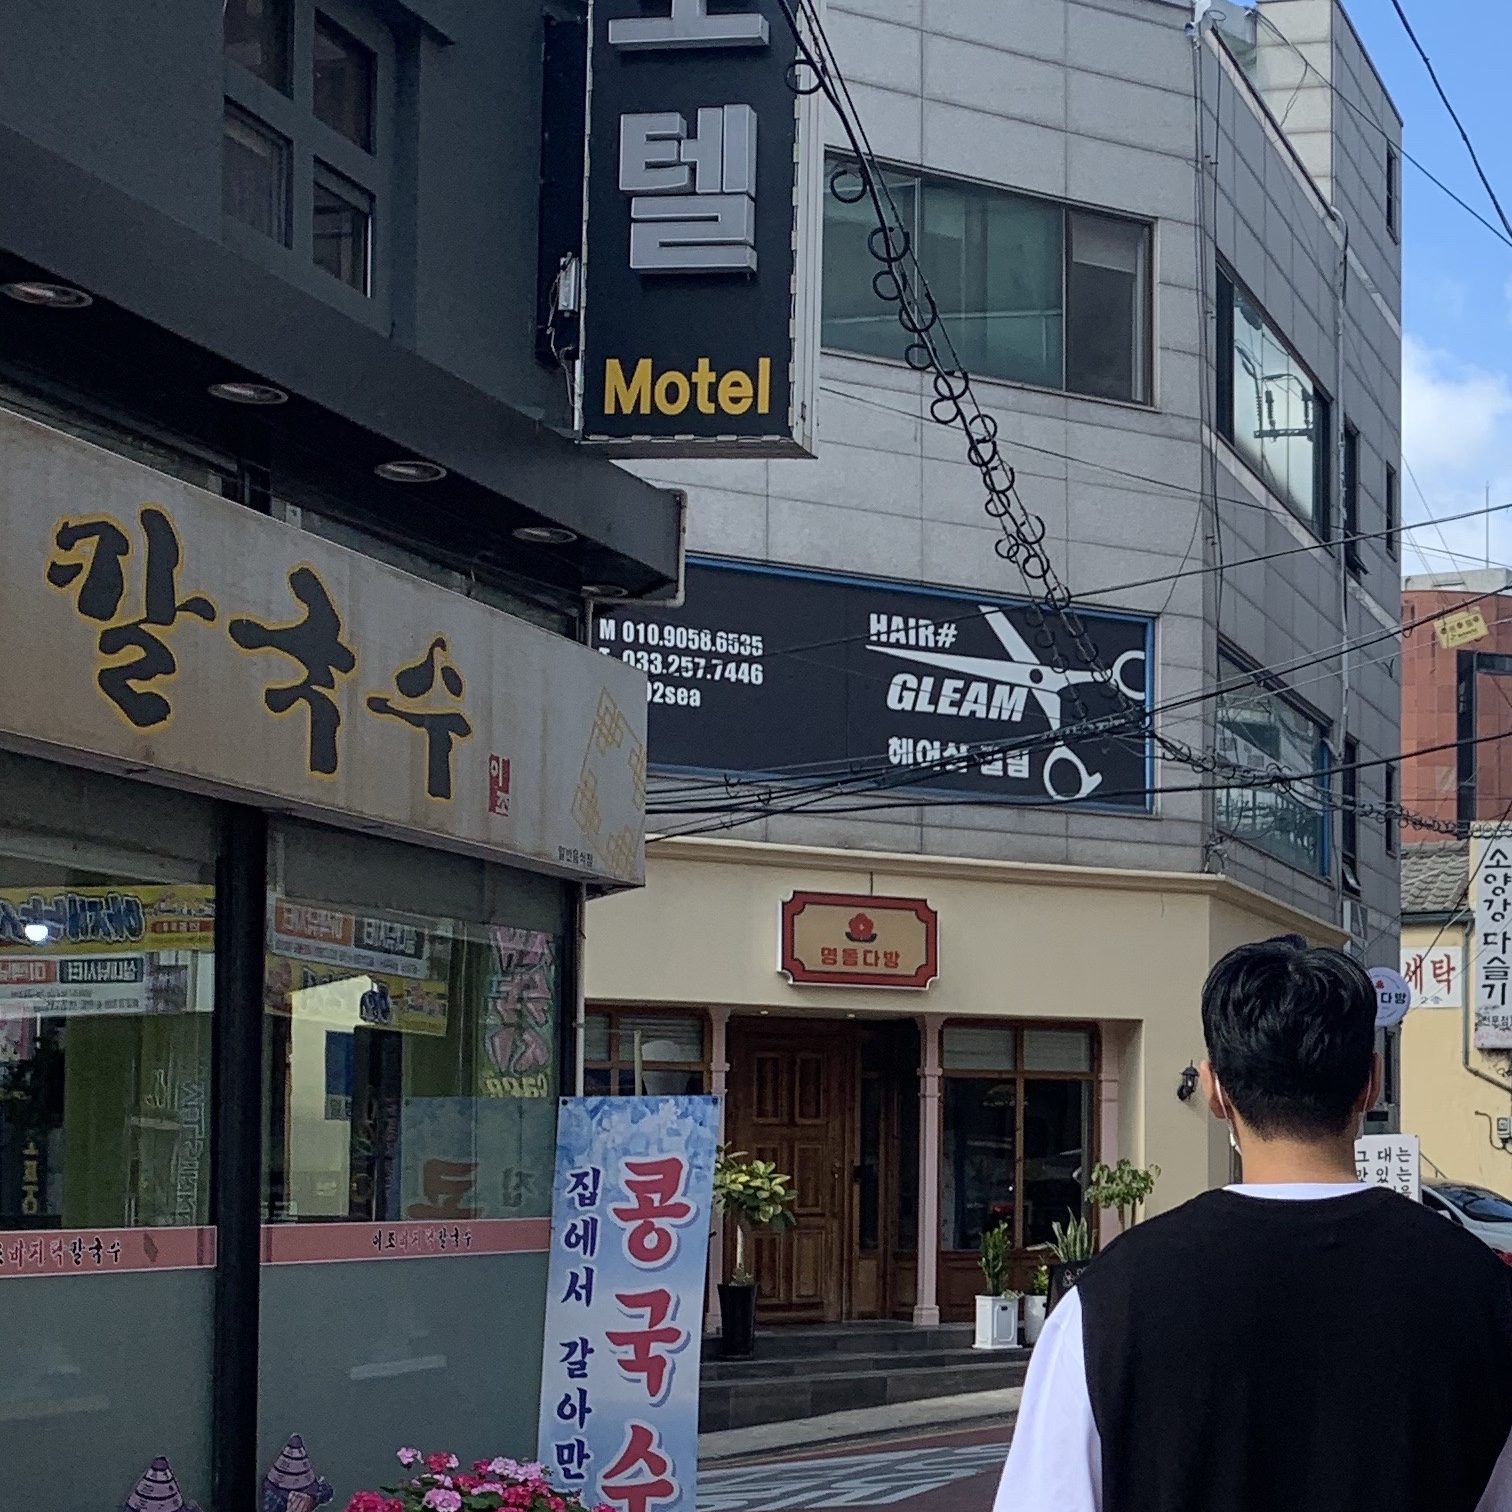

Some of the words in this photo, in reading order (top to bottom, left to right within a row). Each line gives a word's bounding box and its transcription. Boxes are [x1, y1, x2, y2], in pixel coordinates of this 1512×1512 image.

[603, 358, 771, 415] Motel
[46, 501, 475, 802] 칼국수
[599, 618, 616, 641] M
[622, 621, 763, 657] 010.9058.6535
[887, 673, 1029, 722] GLEAM
[1404, 953, 1457, 995] 세탁
[561, 1165, 602, 1310] 집에서
